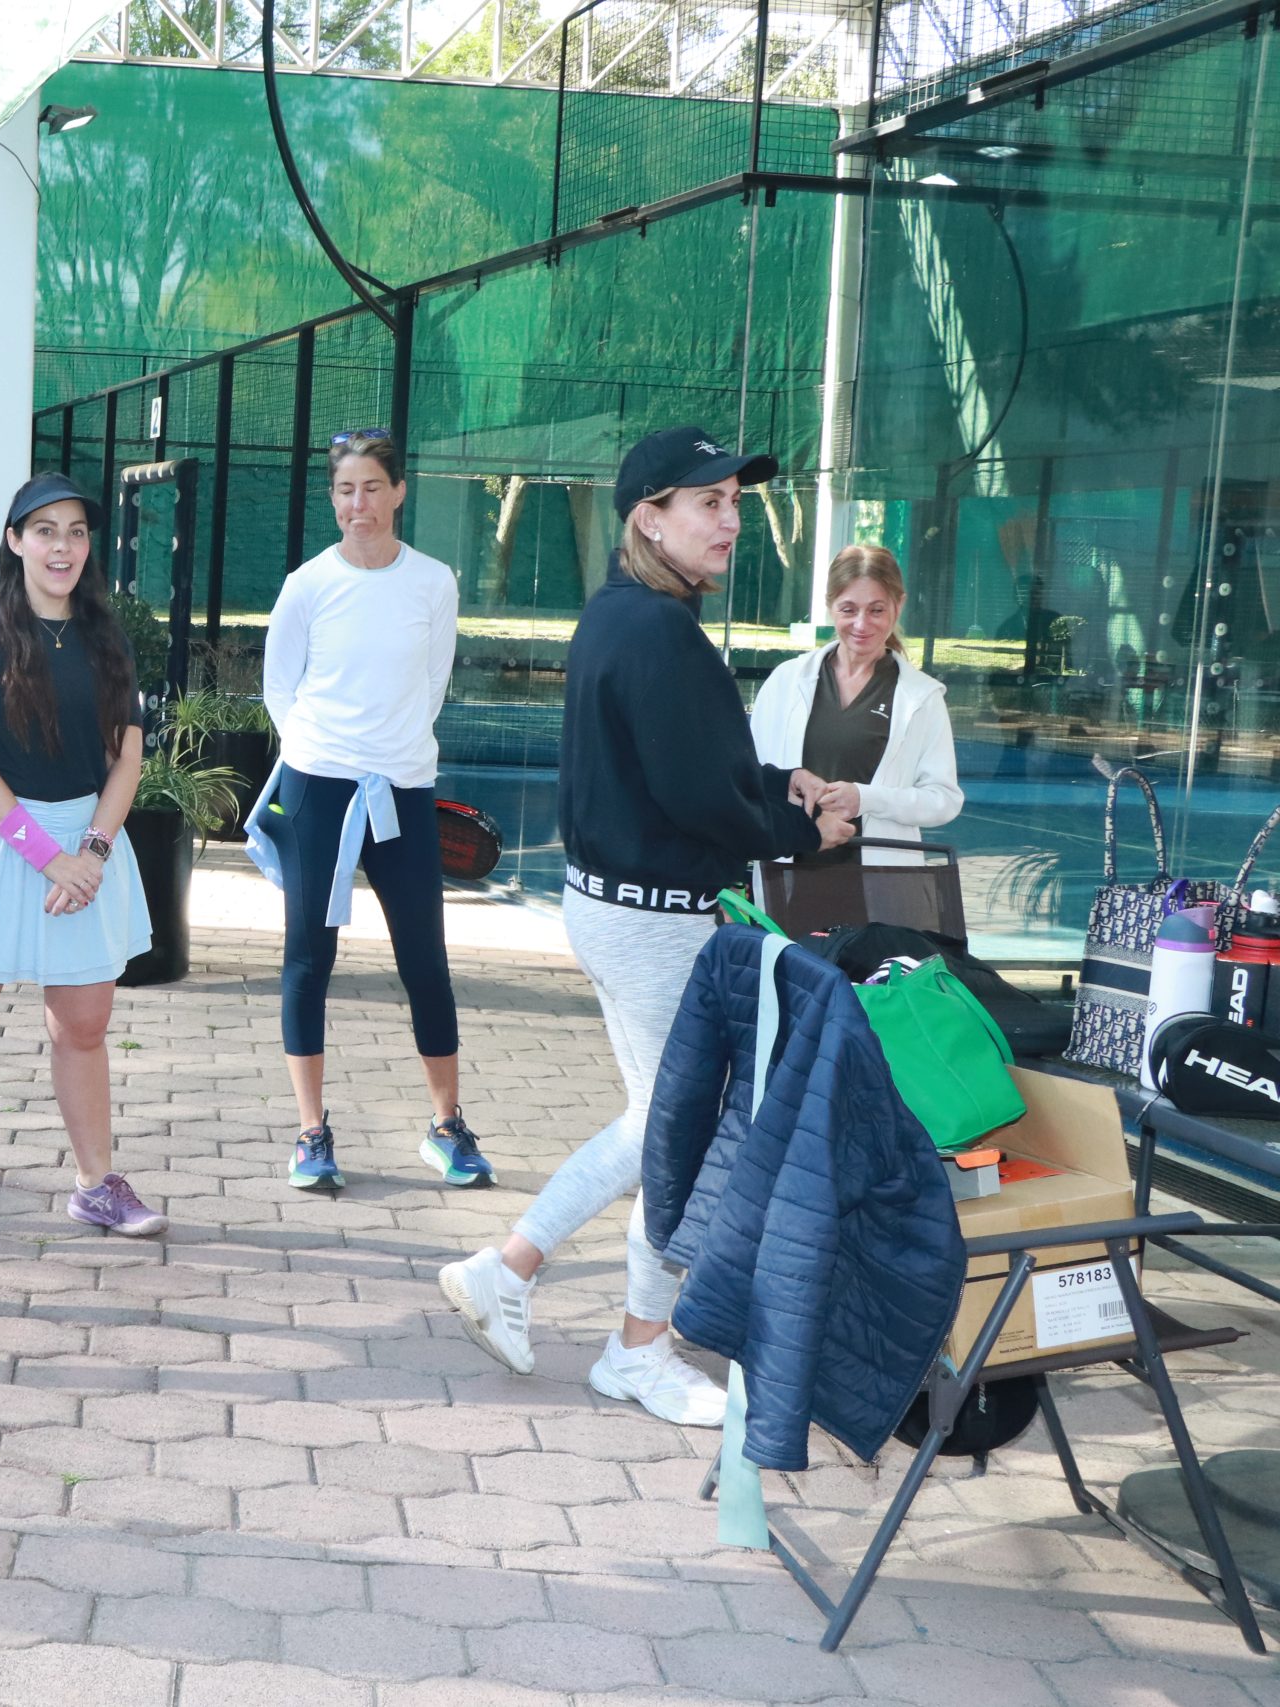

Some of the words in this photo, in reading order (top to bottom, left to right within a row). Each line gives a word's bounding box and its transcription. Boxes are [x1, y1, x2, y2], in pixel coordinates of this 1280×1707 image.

[566, 863, 604, 897] NIKE
[617, 883, 692, 910] AIR
[1228, 968, 1248, 1025] EAD
[1184, 1049, 1280, 1103] HEA
[1058, 1267, 1112, 1288] 578183
